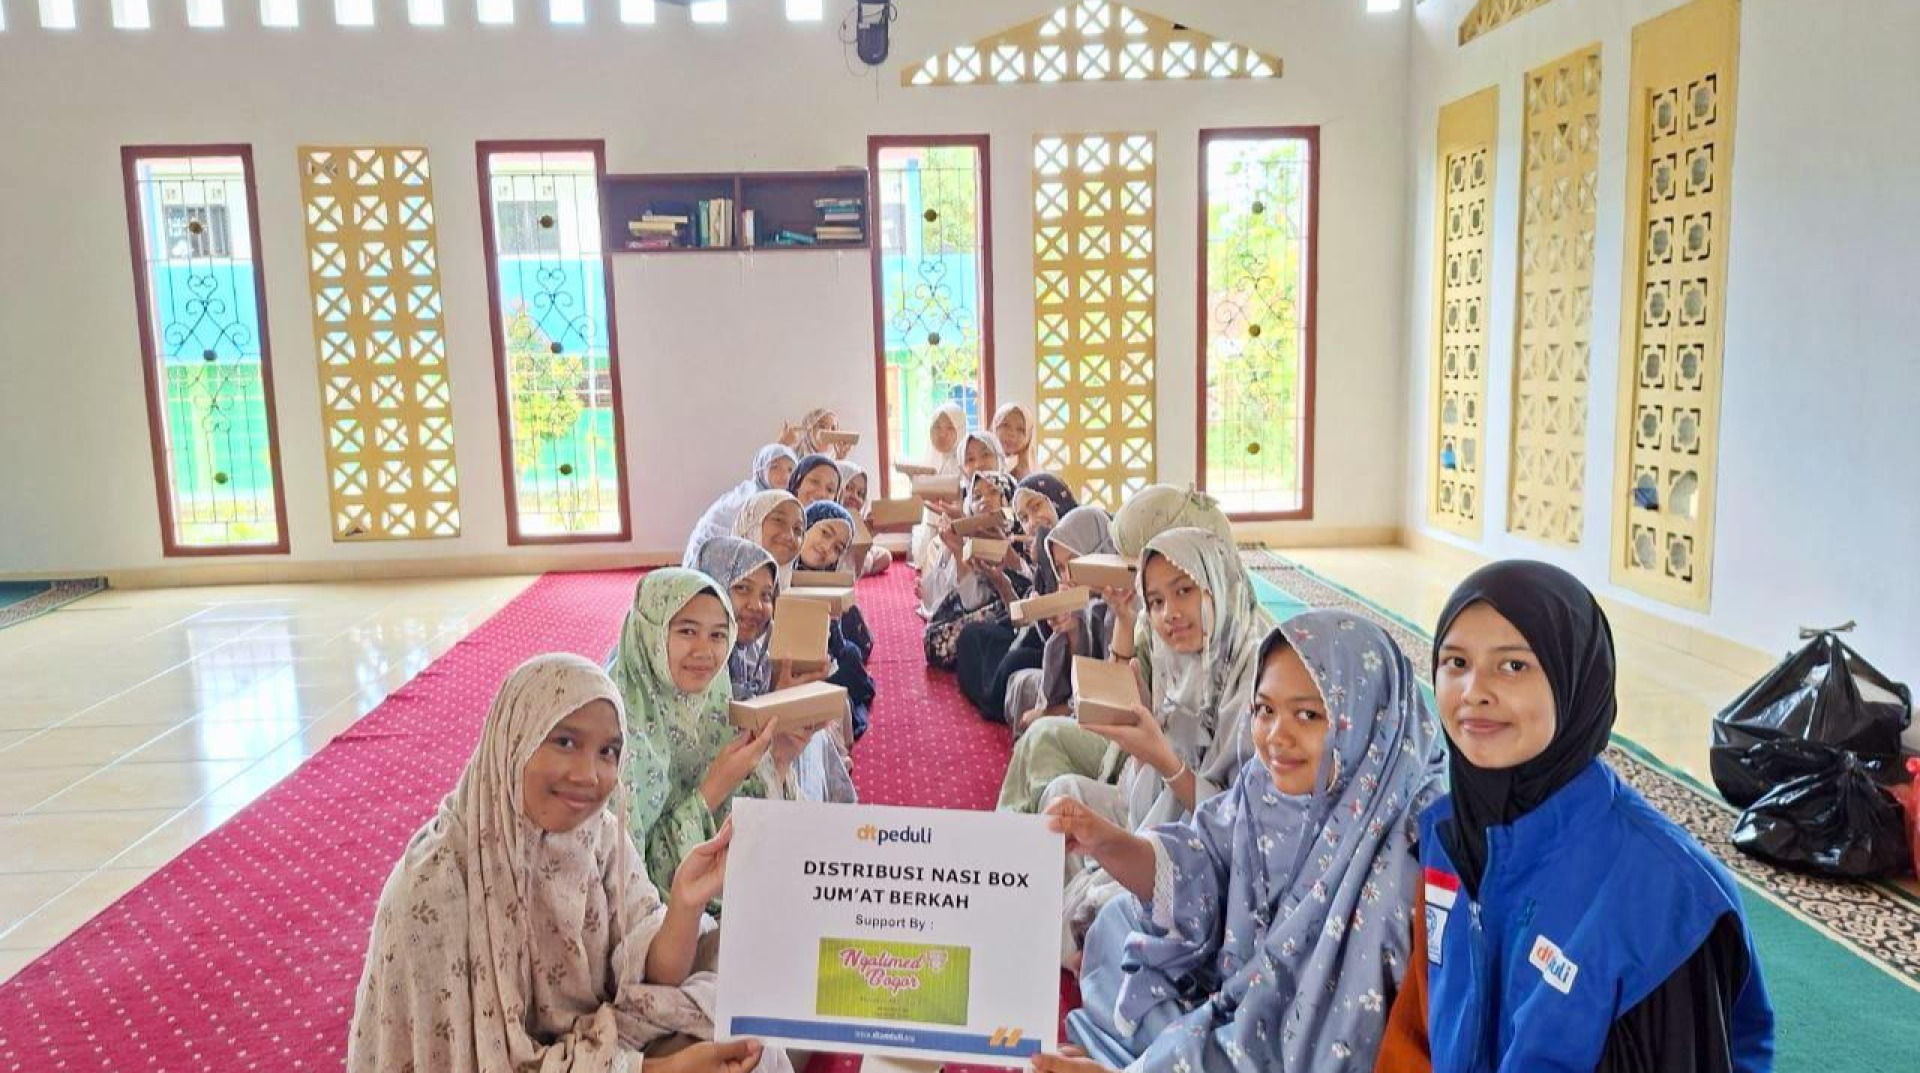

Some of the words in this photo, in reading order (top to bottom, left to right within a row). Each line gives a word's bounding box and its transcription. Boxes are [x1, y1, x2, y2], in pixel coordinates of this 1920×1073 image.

[857, 824, 932, 845] dtpeduli
[803, 860, 924, 881] DISTRIBUSI
[932, 866, 981, 885] NASI
[988, 871, 1030, 888] BOX
[812, 887, 884, 904] JUM'AT
[889, 890, 969, 909] BERKAH
[855, 914, 906, 930] Support
[909, 917, 926, 932] By
